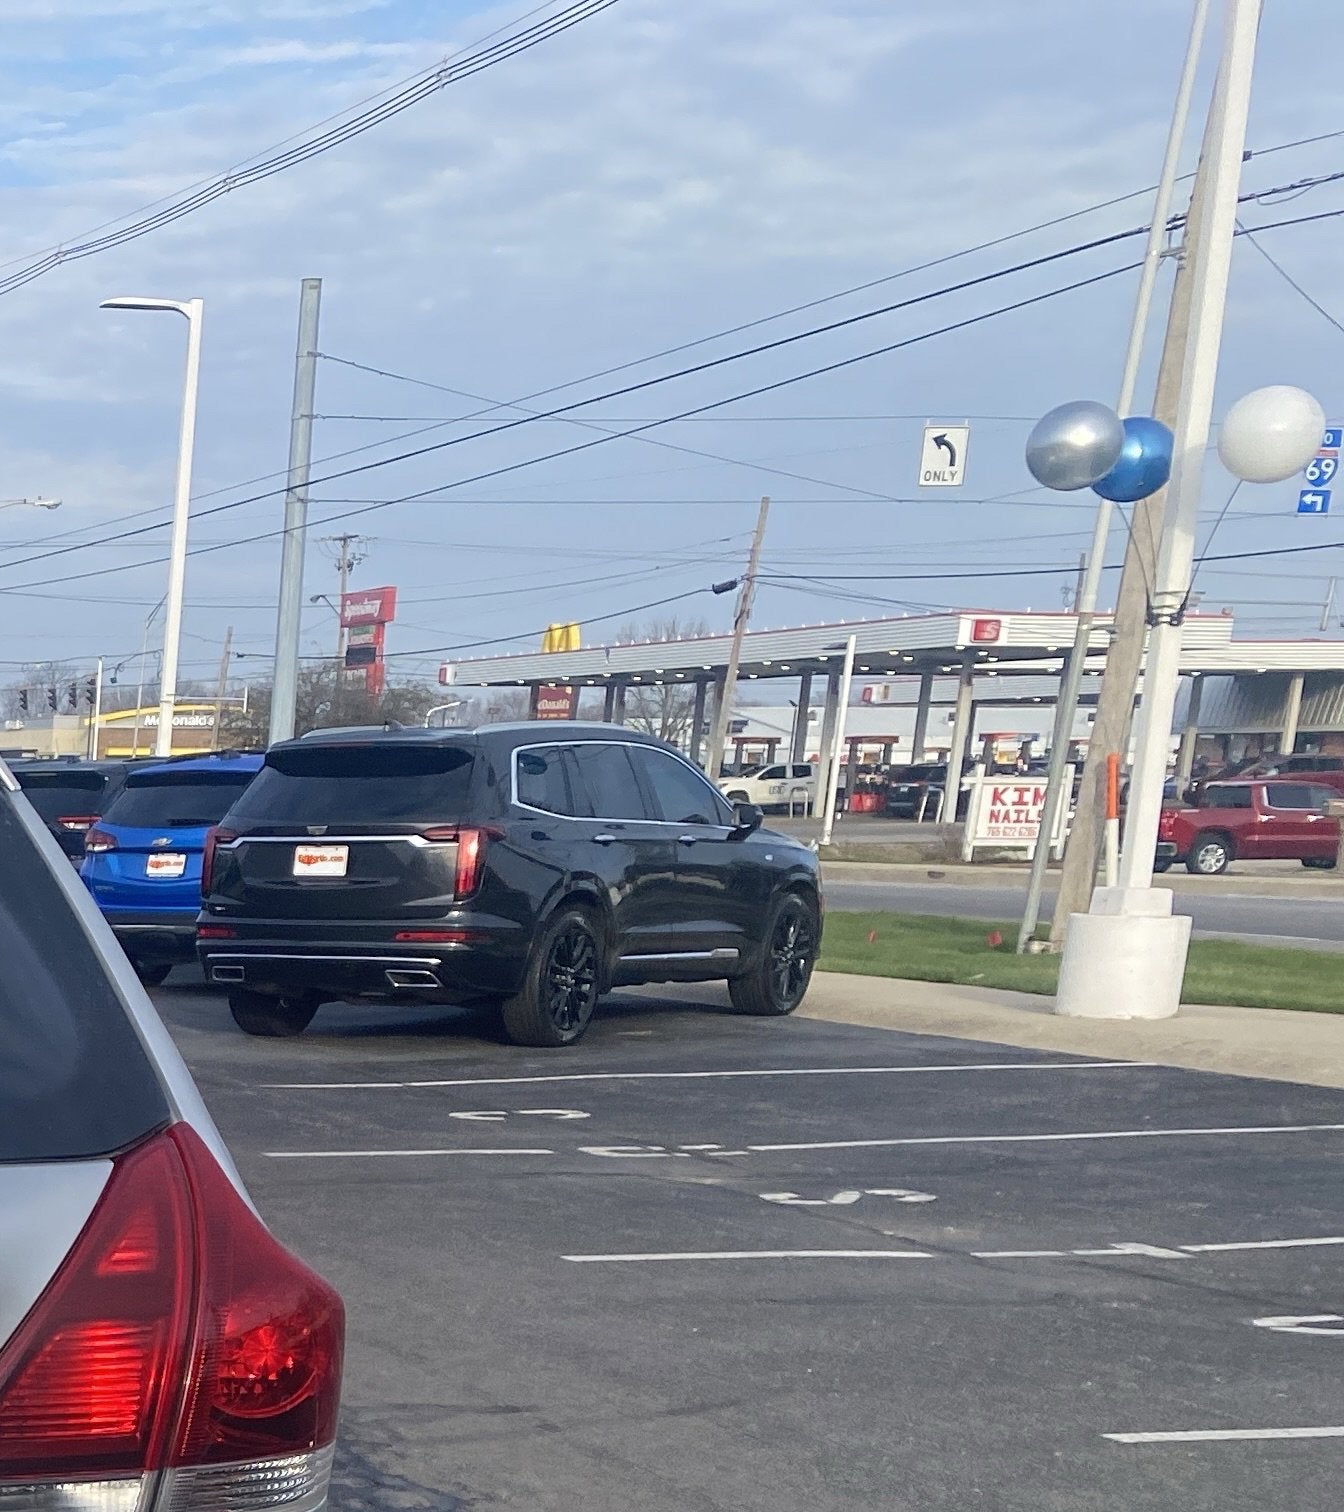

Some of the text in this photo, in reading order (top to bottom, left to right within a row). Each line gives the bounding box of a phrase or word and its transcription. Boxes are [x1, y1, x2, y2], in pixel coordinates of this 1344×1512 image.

[923, 470, 958, 482] ONLY
[1306, 459, 1336, 481] 69
[144, 715, 215, 726] Mconald's
